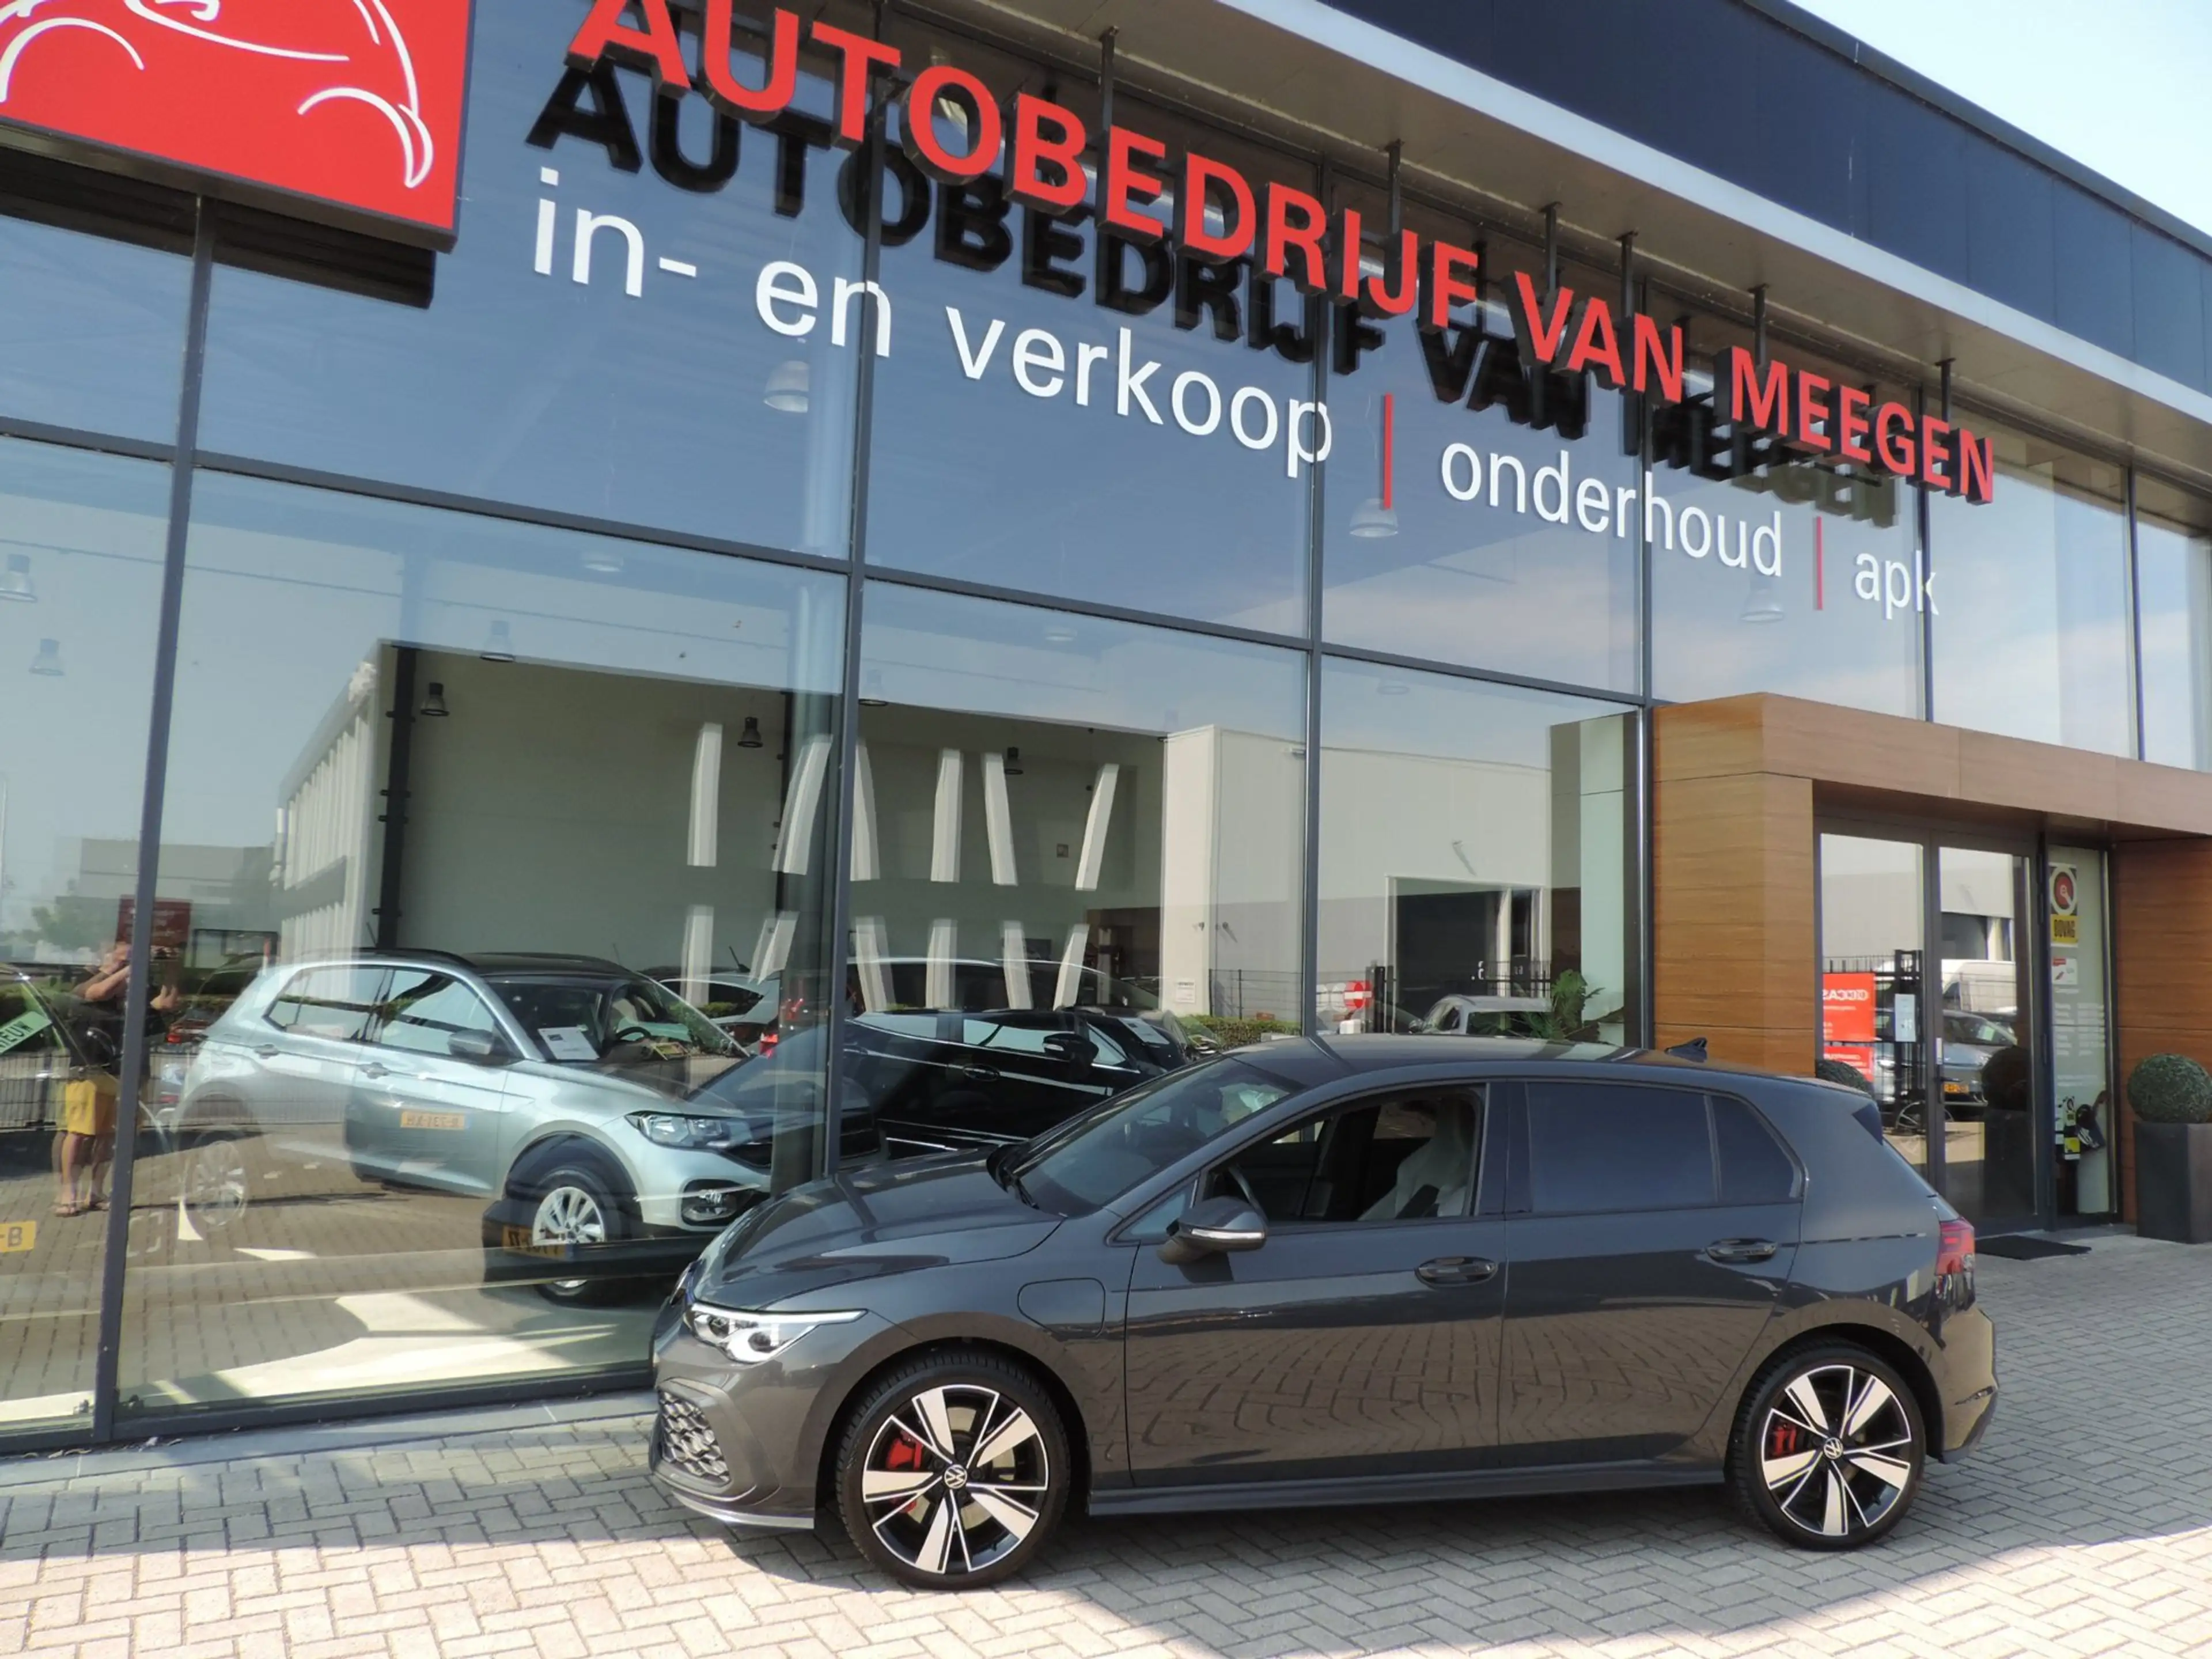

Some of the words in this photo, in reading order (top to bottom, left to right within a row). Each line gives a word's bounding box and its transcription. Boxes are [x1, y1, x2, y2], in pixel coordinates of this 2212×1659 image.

[533, 166, 697, 298] in-
[755, 259, 891, 358] en
[945, 306, 1332, 479] verkoop
[1441, 442, 1781, 577] onderhoud
[1854, 550, 1939, 620] apk
[567, 0, 1479, 329] AUTOBEDRIJF
[1514, 270, 1683, 404] VAN
[1731, 346, 1994, 505] MEEGEN
